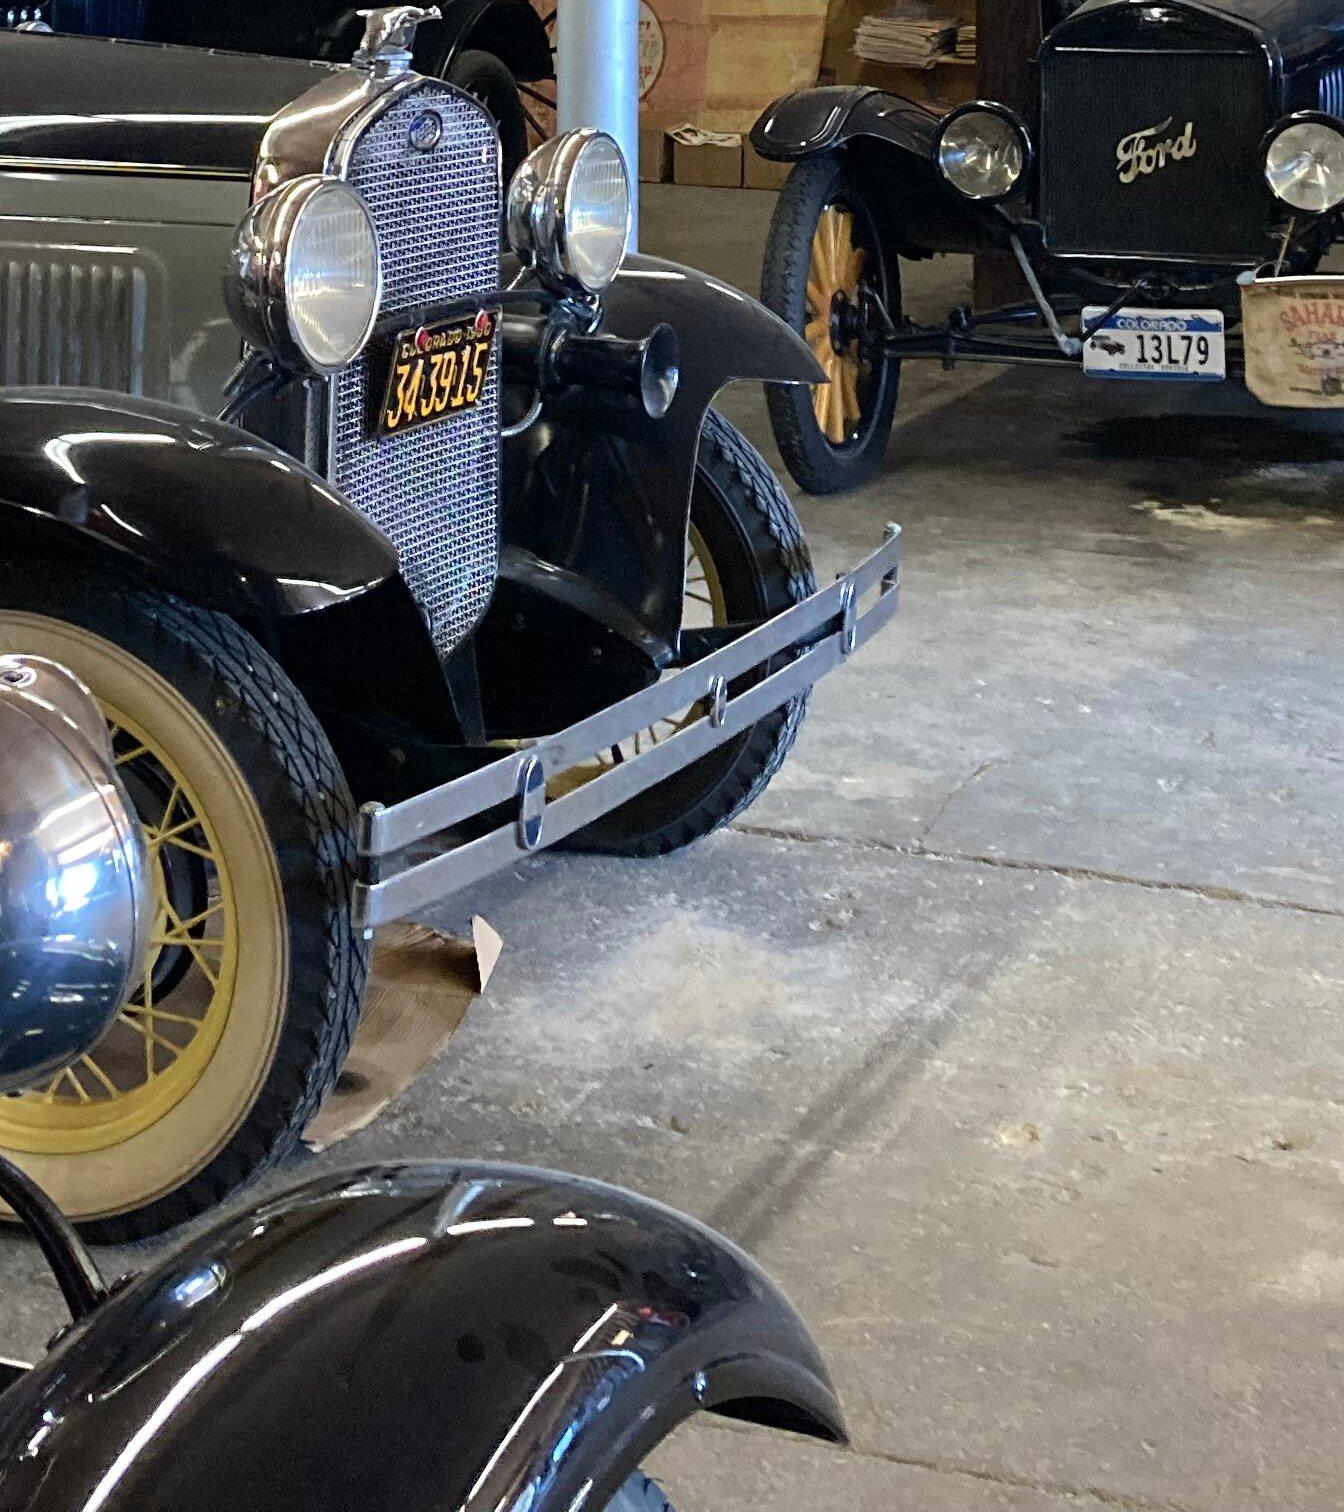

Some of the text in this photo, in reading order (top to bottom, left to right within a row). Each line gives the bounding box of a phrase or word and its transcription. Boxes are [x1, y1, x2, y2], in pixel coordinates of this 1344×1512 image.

[1116, 115, 1198, 184] Ford
[1116, 317, 1188, 330] COLORADO
[1136, 333, 1210, 366] 13L79
